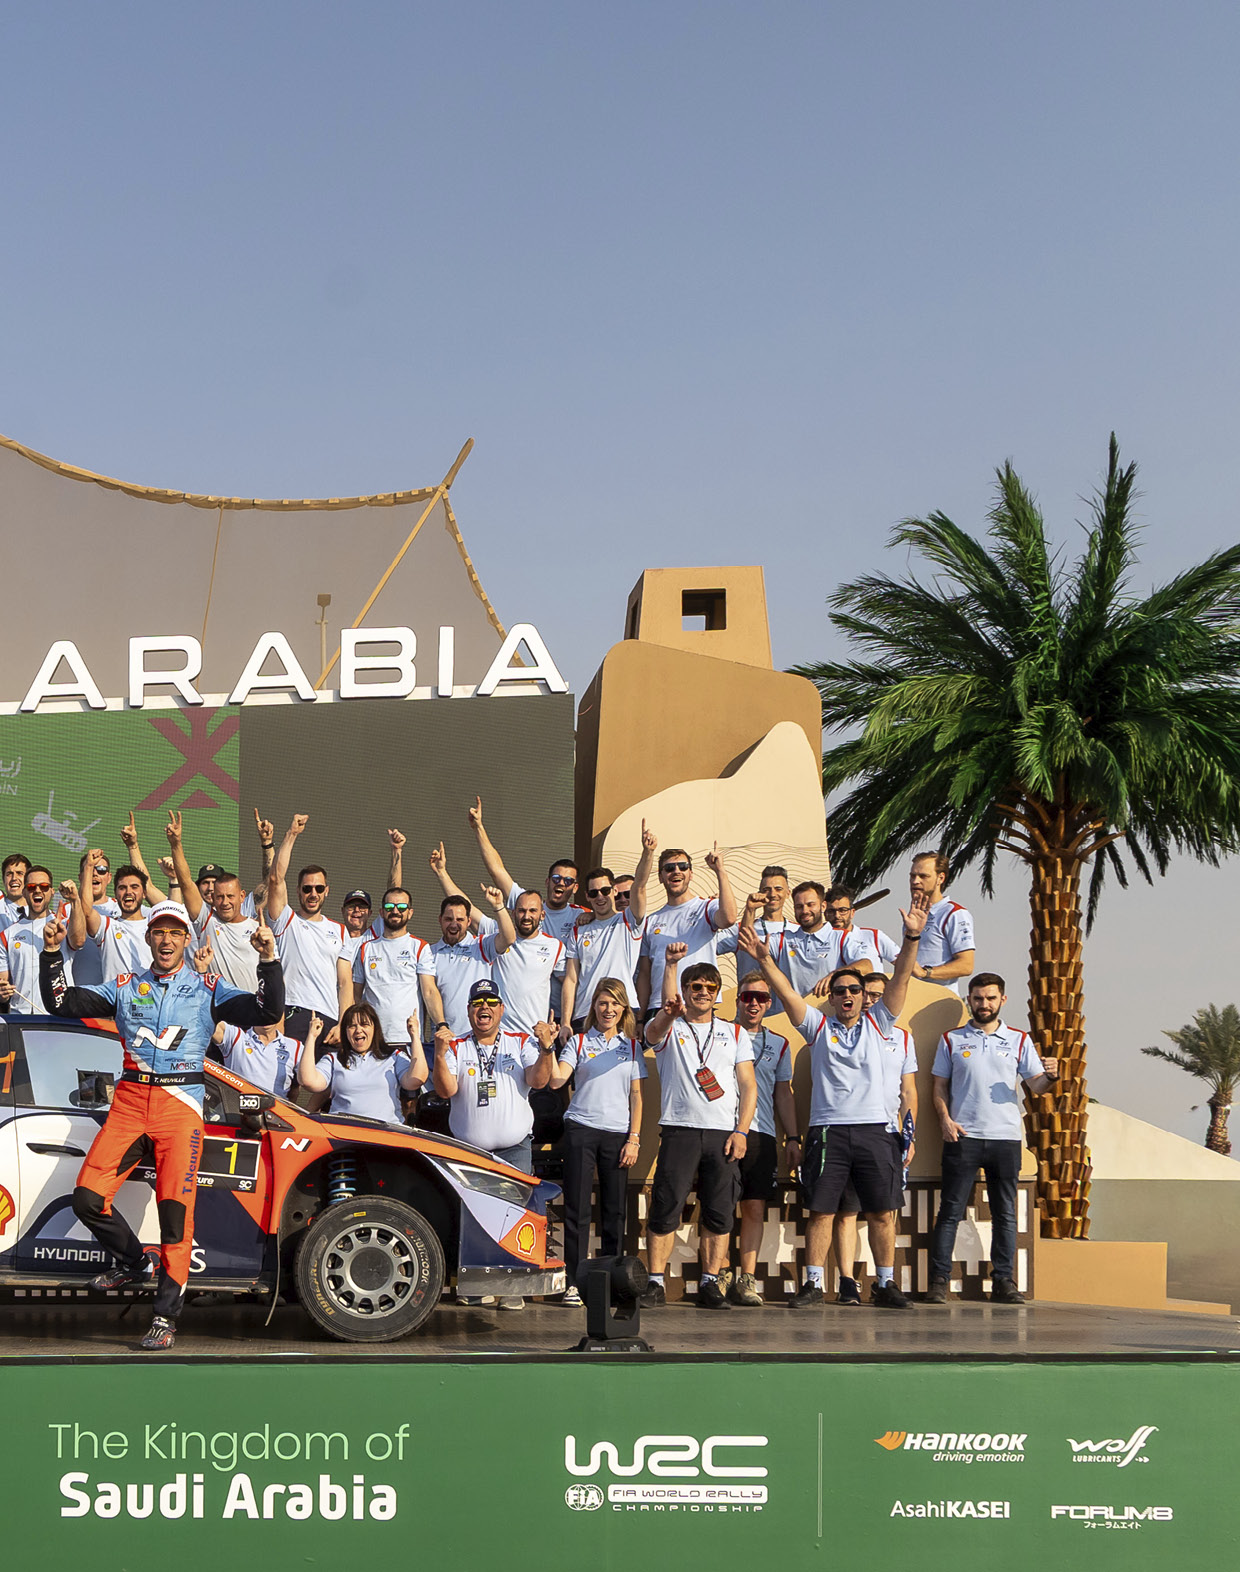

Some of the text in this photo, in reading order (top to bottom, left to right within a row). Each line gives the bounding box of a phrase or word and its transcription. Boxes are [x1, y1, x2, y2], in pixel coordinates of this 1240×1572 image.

[20, 622, 569, 712] ARABIA
[170, 1062, 197, 1071] MOBIS
[224, 1142, 239, 1175] 1
[238, 1180, 252, 1189] SC
[34, 1247, 106, 1263] HYUNDAI
[49, 1422, 410, 1472] The Kingdom of
[565, 1435, 768, 1477] WRC
[933, 1452, 1025, 1464] driving emotion
[1072, 1455, 1121, 1463] LUBRICANTS
[59, 1471, 397, 1520] Saudi Arabia
[613, 1489, 763, 1498] FIA WORLD RALLY
[612, 1504, 763, 1513] CHAMPIONSHIP
[1050, 1505, 1174, 1521] FORUM8
[1083, 1520, 1142, 1530] フォーラムエイト
